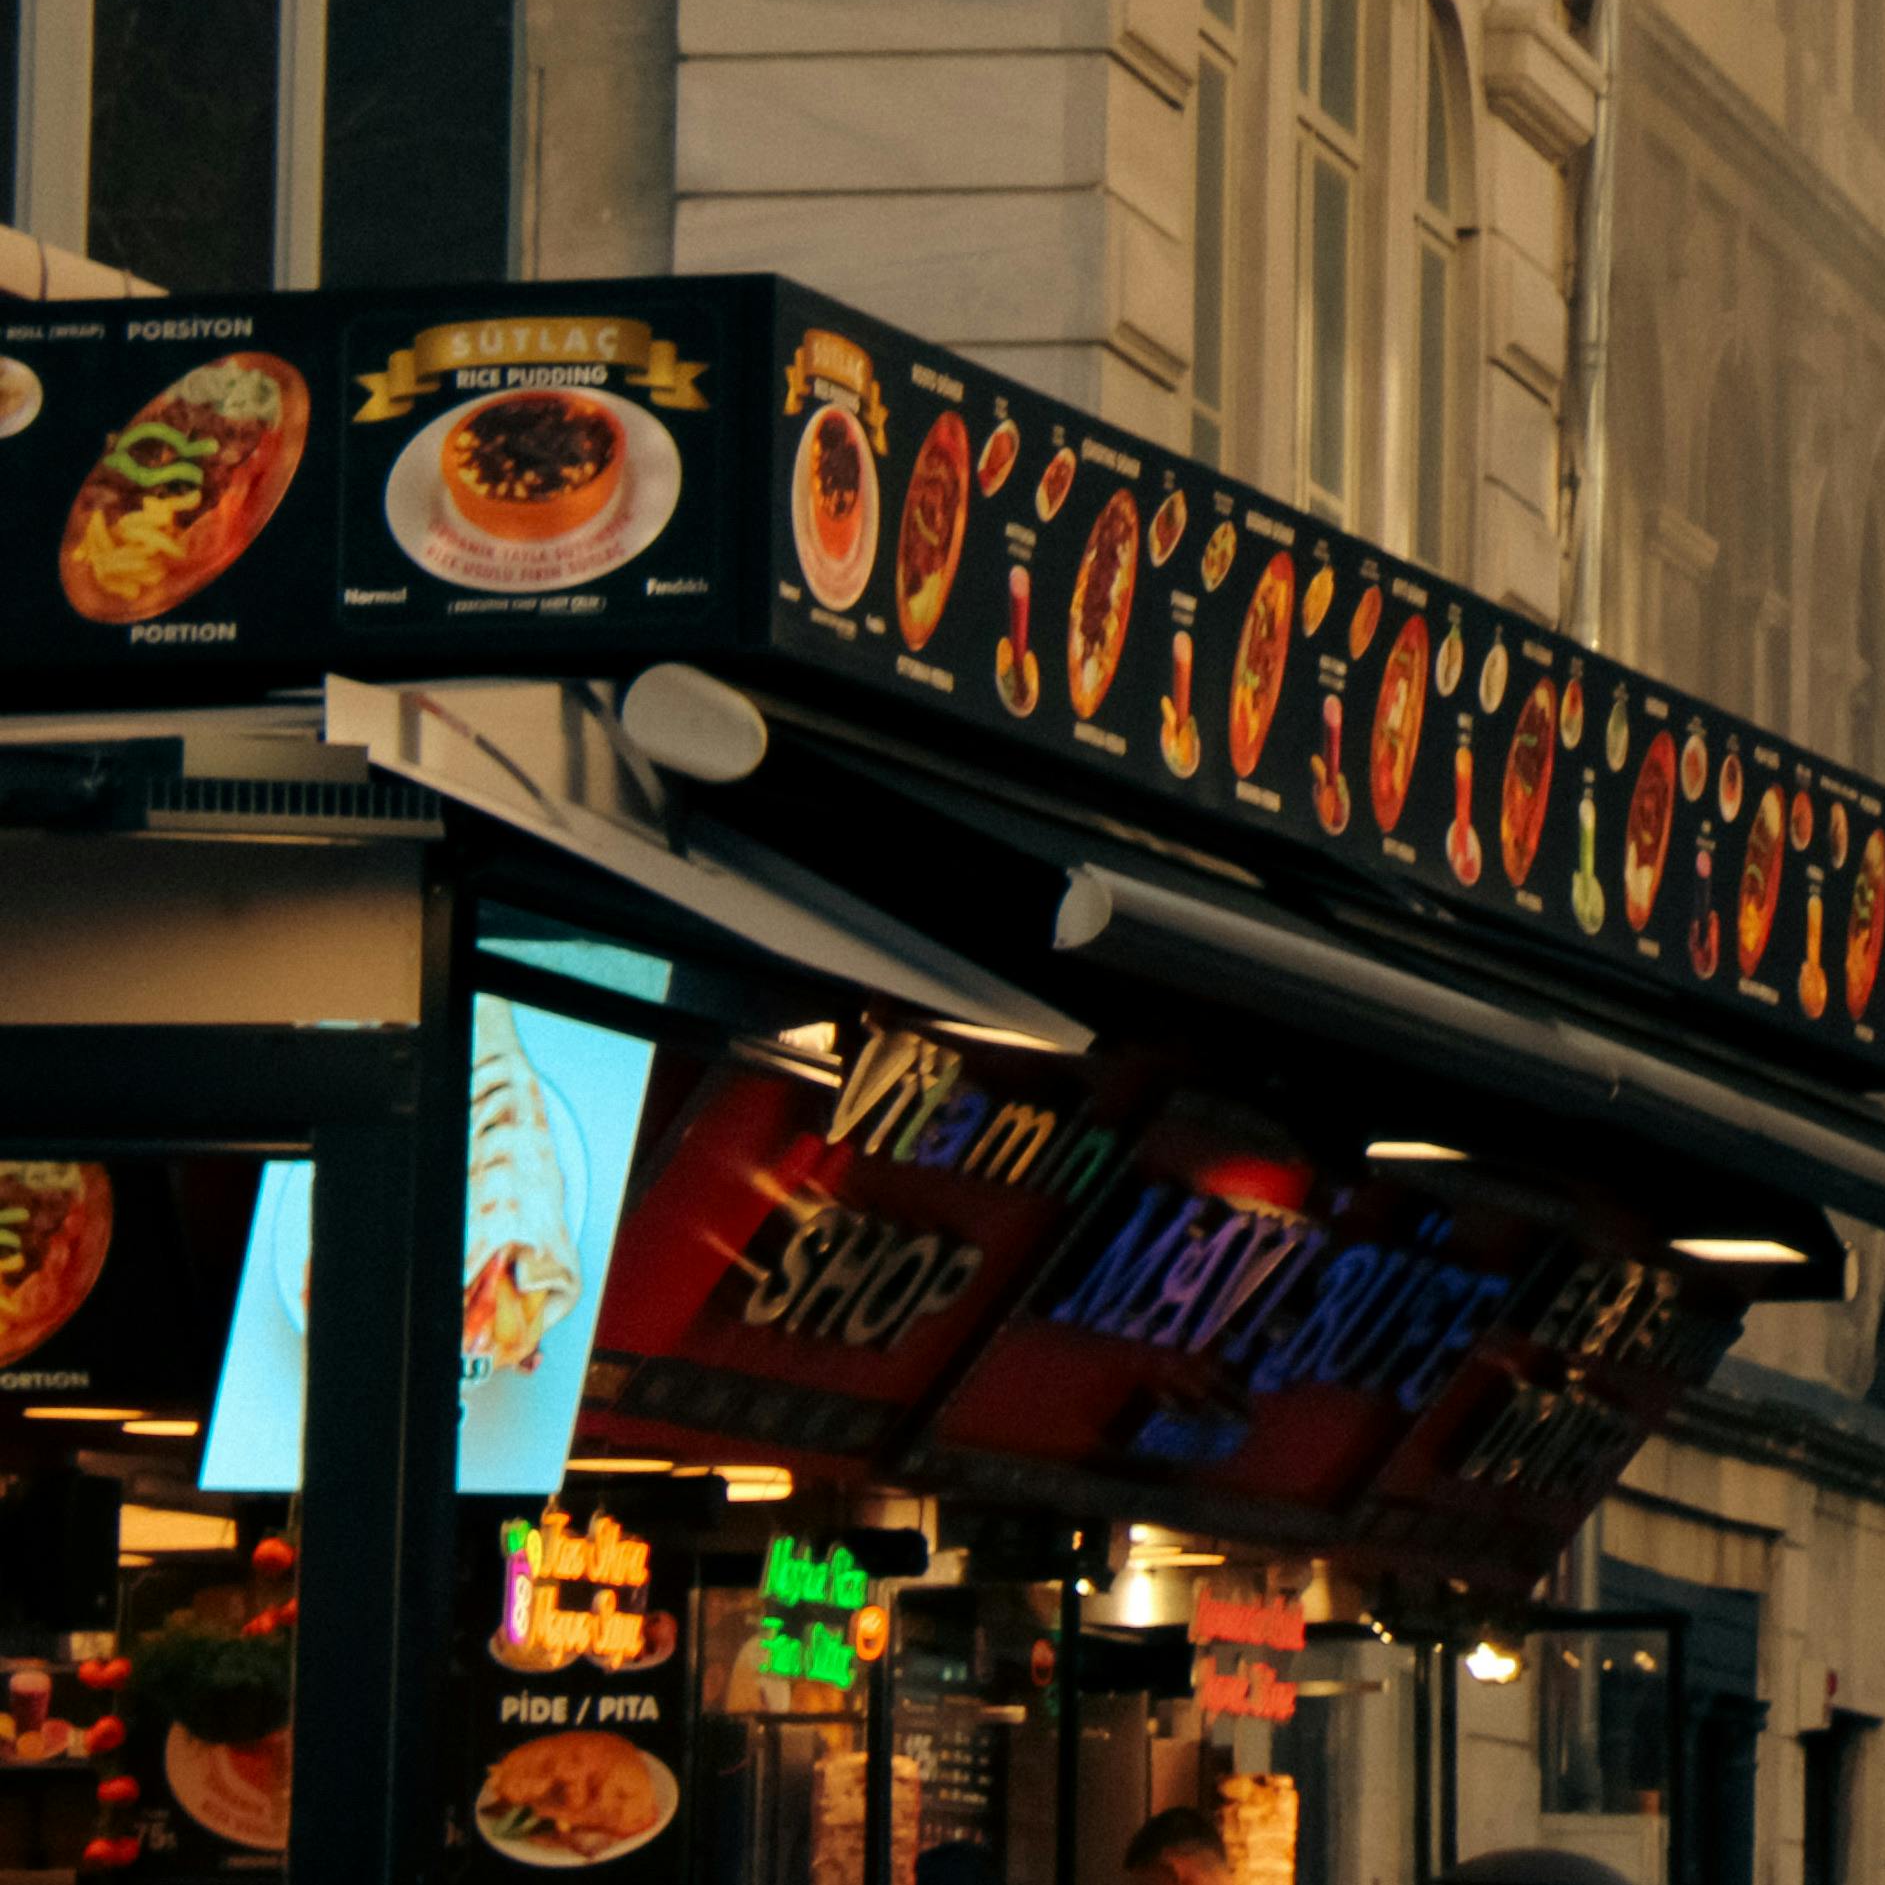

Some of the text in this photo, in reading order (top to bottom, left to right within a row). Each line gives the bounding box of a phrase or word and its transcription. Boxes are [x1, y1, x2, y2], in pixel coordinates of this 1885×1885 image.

[126, 314, 254, 341] PORSİYON
[451, 325, 621, 360] SÜTLAÇ
[455, 364, 608, 390] RICE PUDDING
[130, 620, 239, 646] PORTION
[742, 1202, 985, 1355] SHOP
[499, 1688, 571, 1727] PİDE
[597, 1694, 662, 1725] PITA
